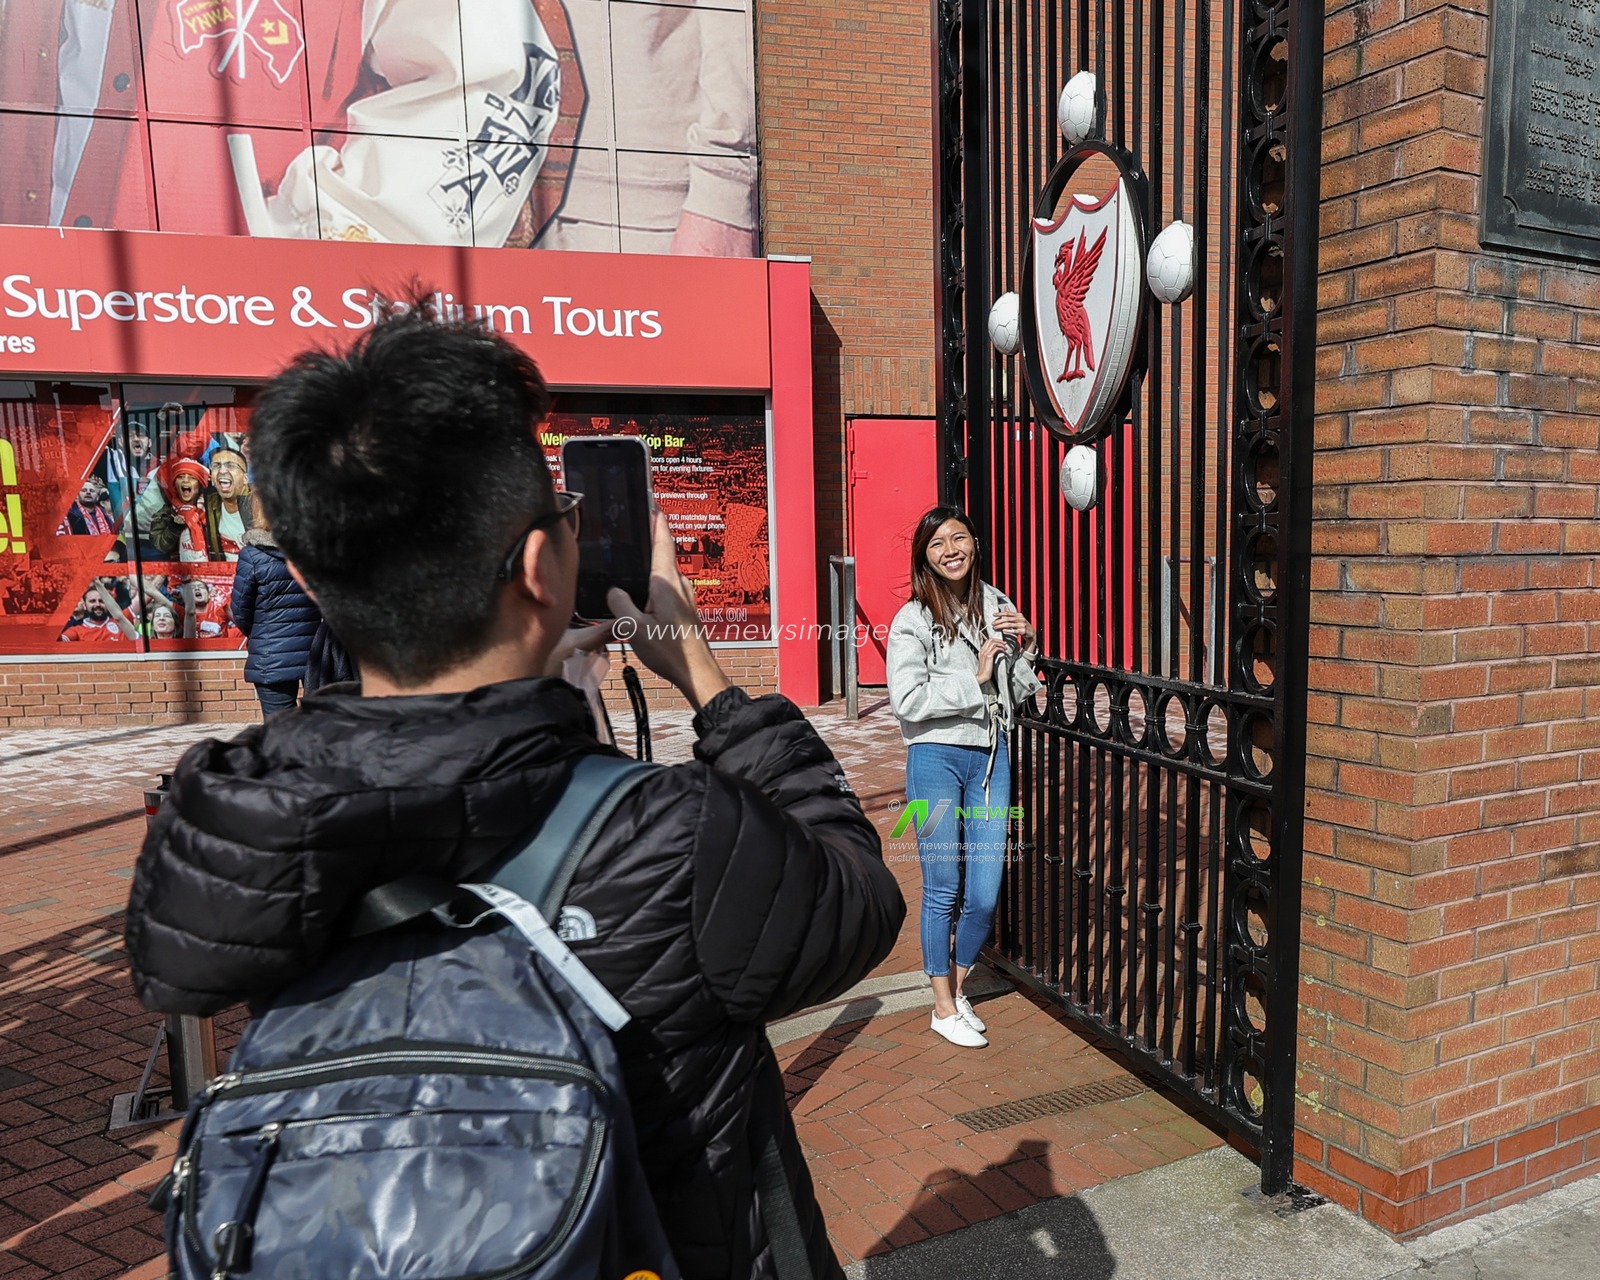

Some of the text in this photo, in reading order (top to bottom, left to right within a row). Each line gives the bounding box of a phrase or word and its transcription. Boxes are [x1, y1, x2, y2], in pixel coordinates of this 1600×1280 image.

[185, 6, 235, 35] YNWA
[2, 274, 275, 331] Superstore
[289, 285, 338, 328] &
[541, 295, 663, 338] Tours
[664, 434, 686, 448] Bar
[665, 456, 680, 464] open
[686, 456, 702, 464] hours
[660, 464, 669, 472] for
[669, 465, 691, 473] evening
[686, 492, 708, 500] through
[680, 513, 708, 522] matchday
[707, 523, 728, 531] phone.
[676, 535, 697, 544] prices.
[694, 578, 720, 587] fantastic
[725, 607, 748, 622] ON
